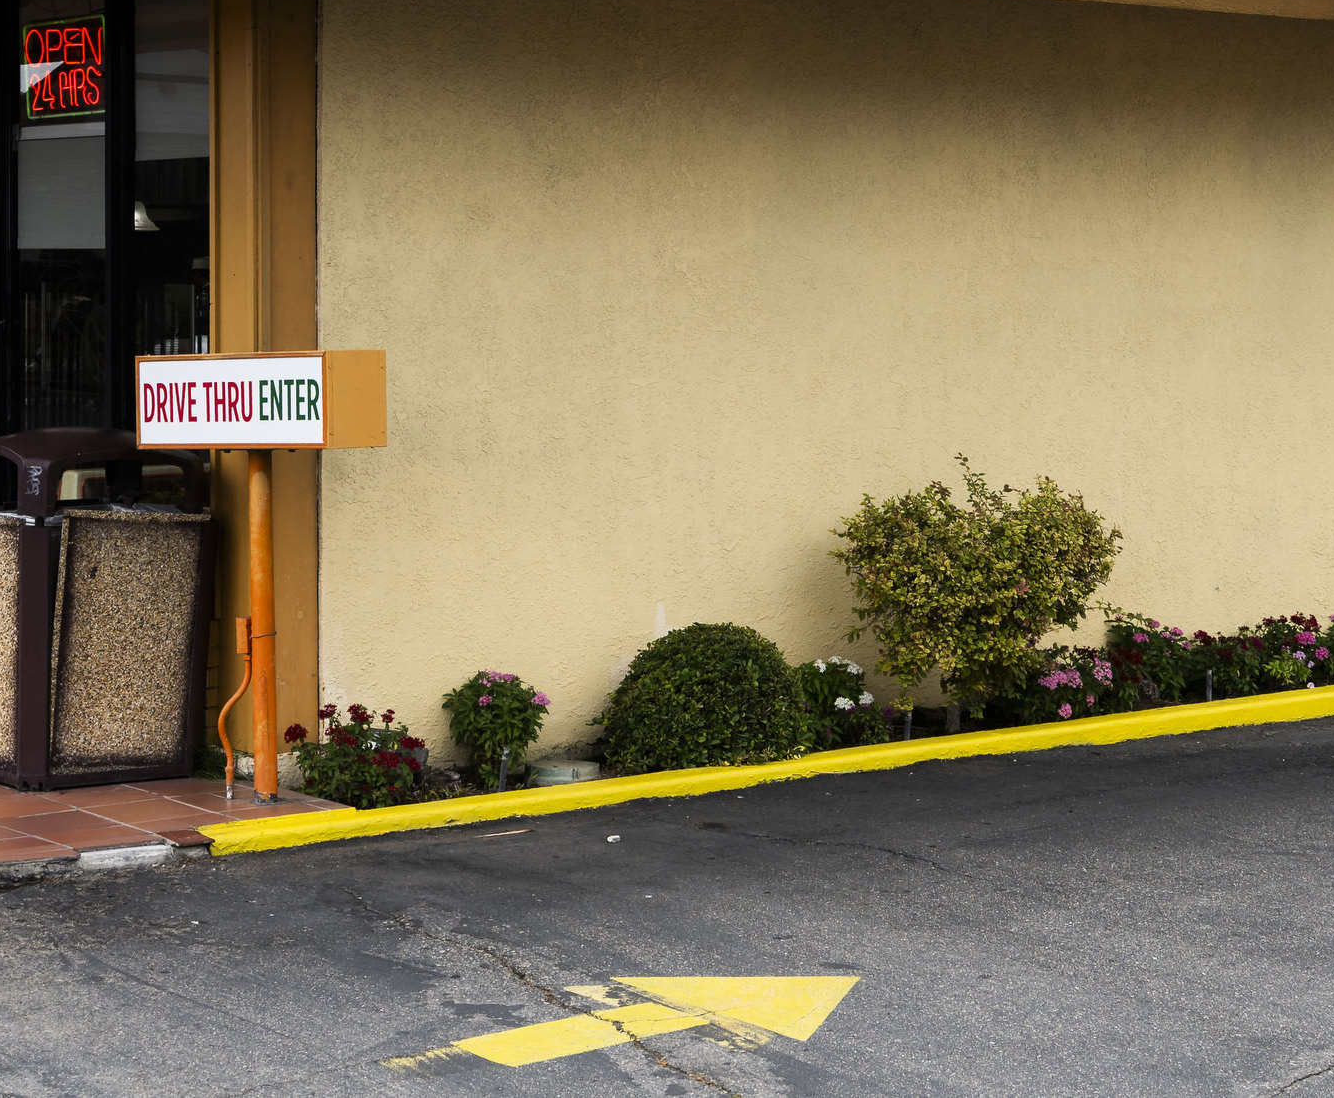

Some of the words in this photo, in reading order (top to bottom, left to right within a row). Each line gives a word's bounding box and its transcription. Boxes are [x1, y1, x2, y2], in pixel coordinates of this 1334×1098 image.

[25, 26, 104, 68] OPEN
[29, 70, 56, 111] 24
[58, 65, 103, 108] HRS
[143, 382, 198, 423] DRIVE
[202, 380, 254, 423] THRU
[258, 378, 321, 422] ENTER
